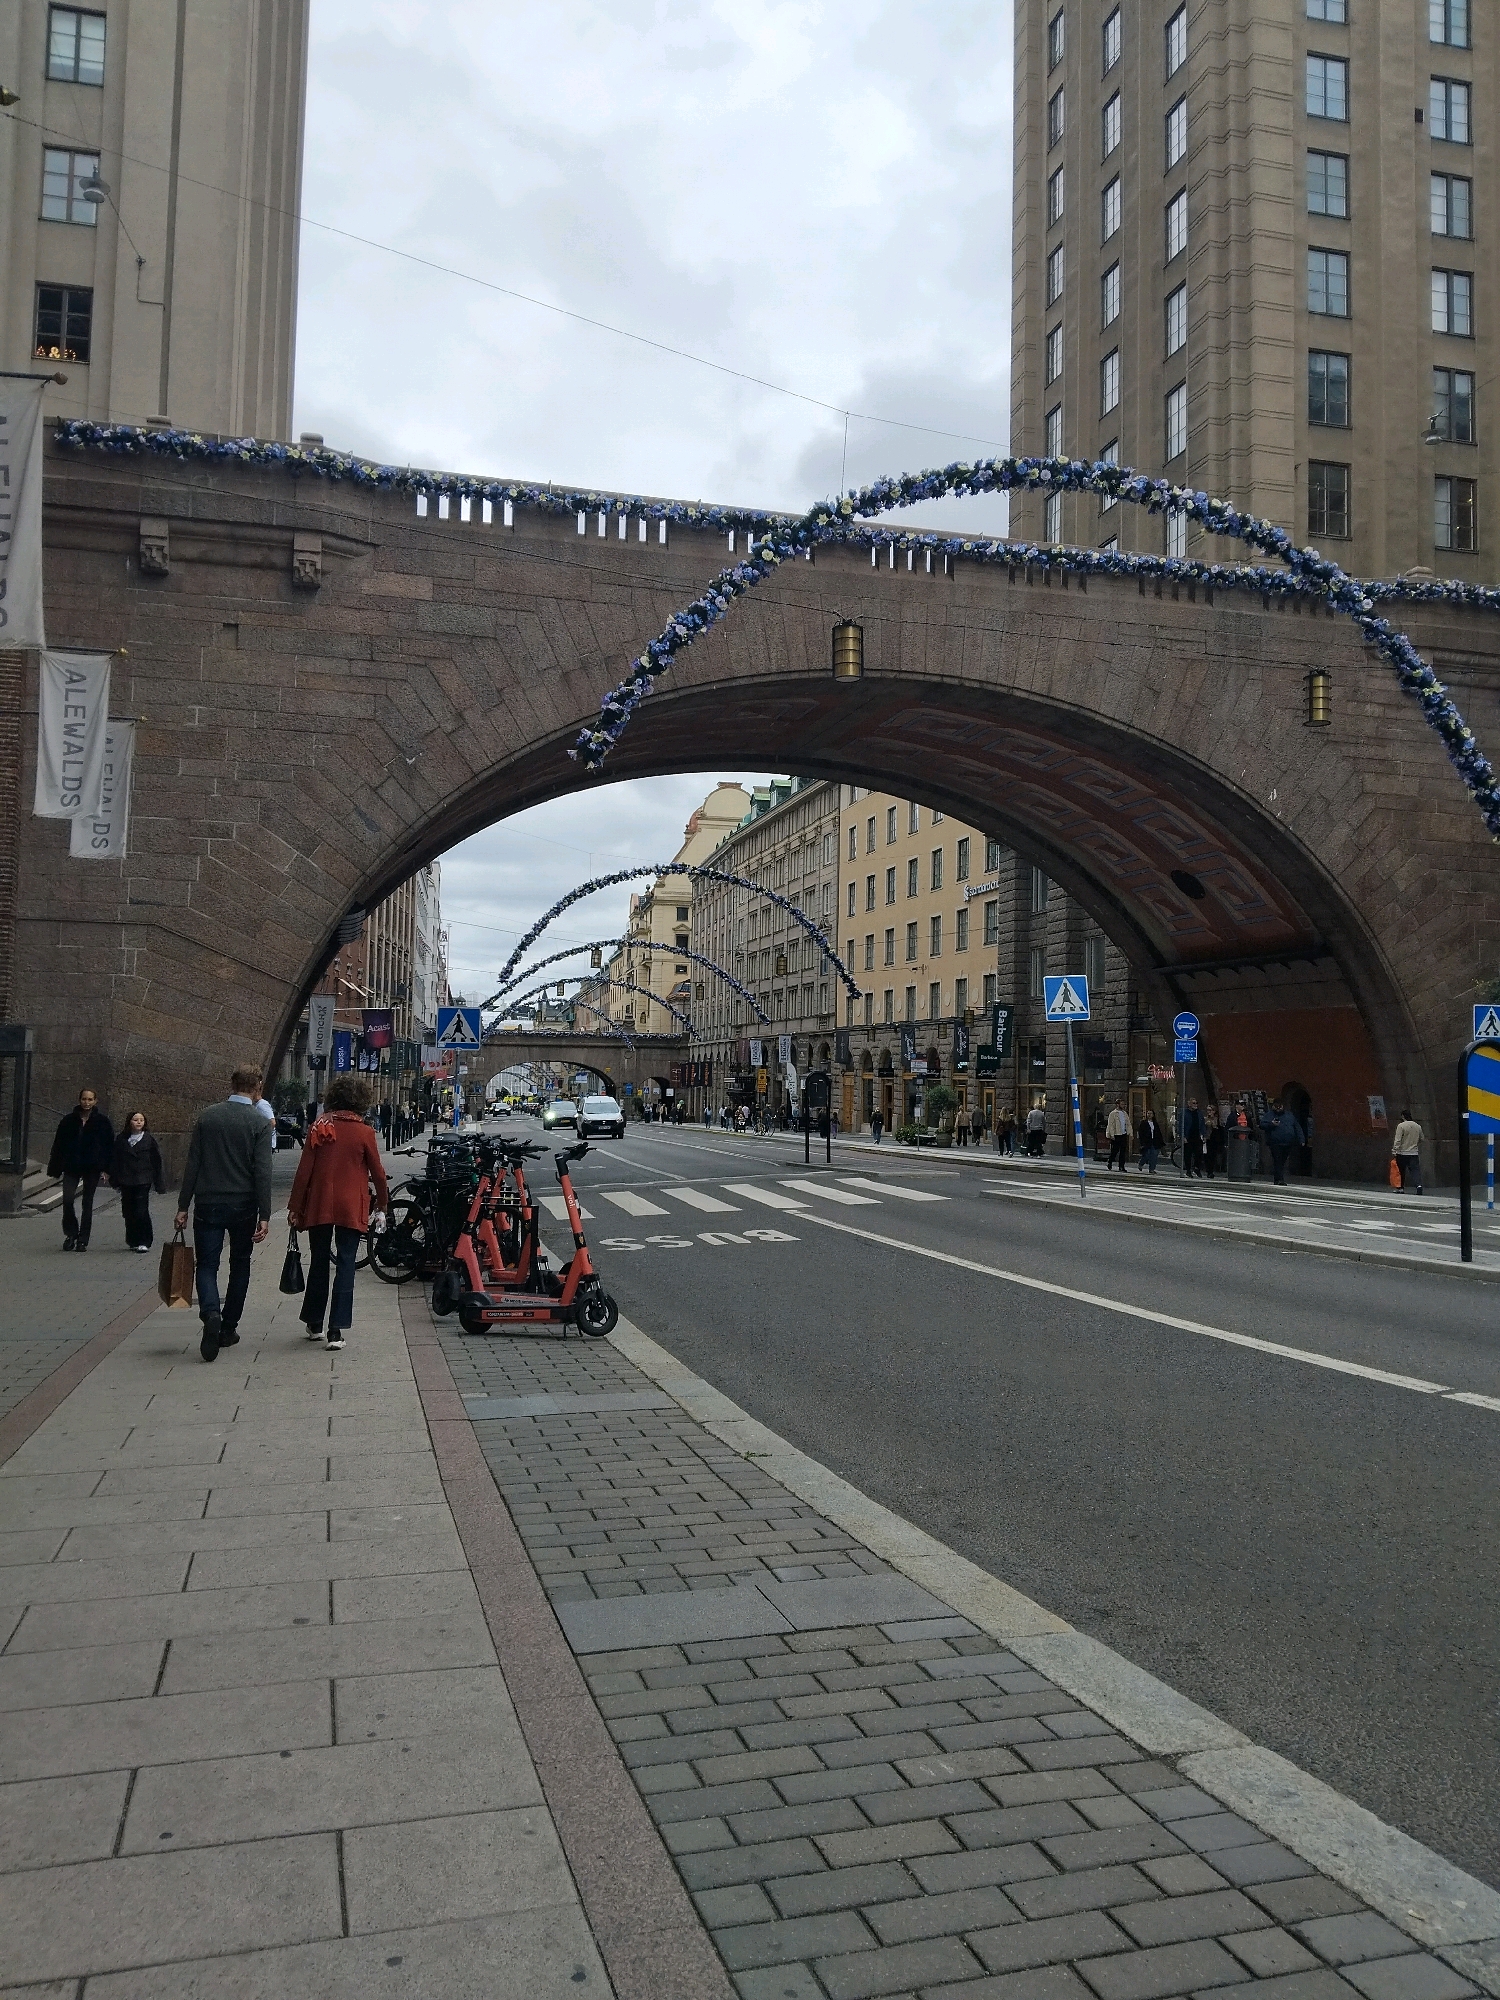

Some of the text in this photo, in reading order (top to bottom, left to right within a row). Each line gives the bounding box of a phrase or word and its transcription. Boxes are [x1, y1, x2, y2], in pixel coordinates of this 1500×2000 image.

[60, 668, 87, 808] ALEWALDS
[367, 1023, 391, 1032] Acast
[996, 1010, 1008, 1053] Barbour
[599, 1229, 801, 1251] BUSS
